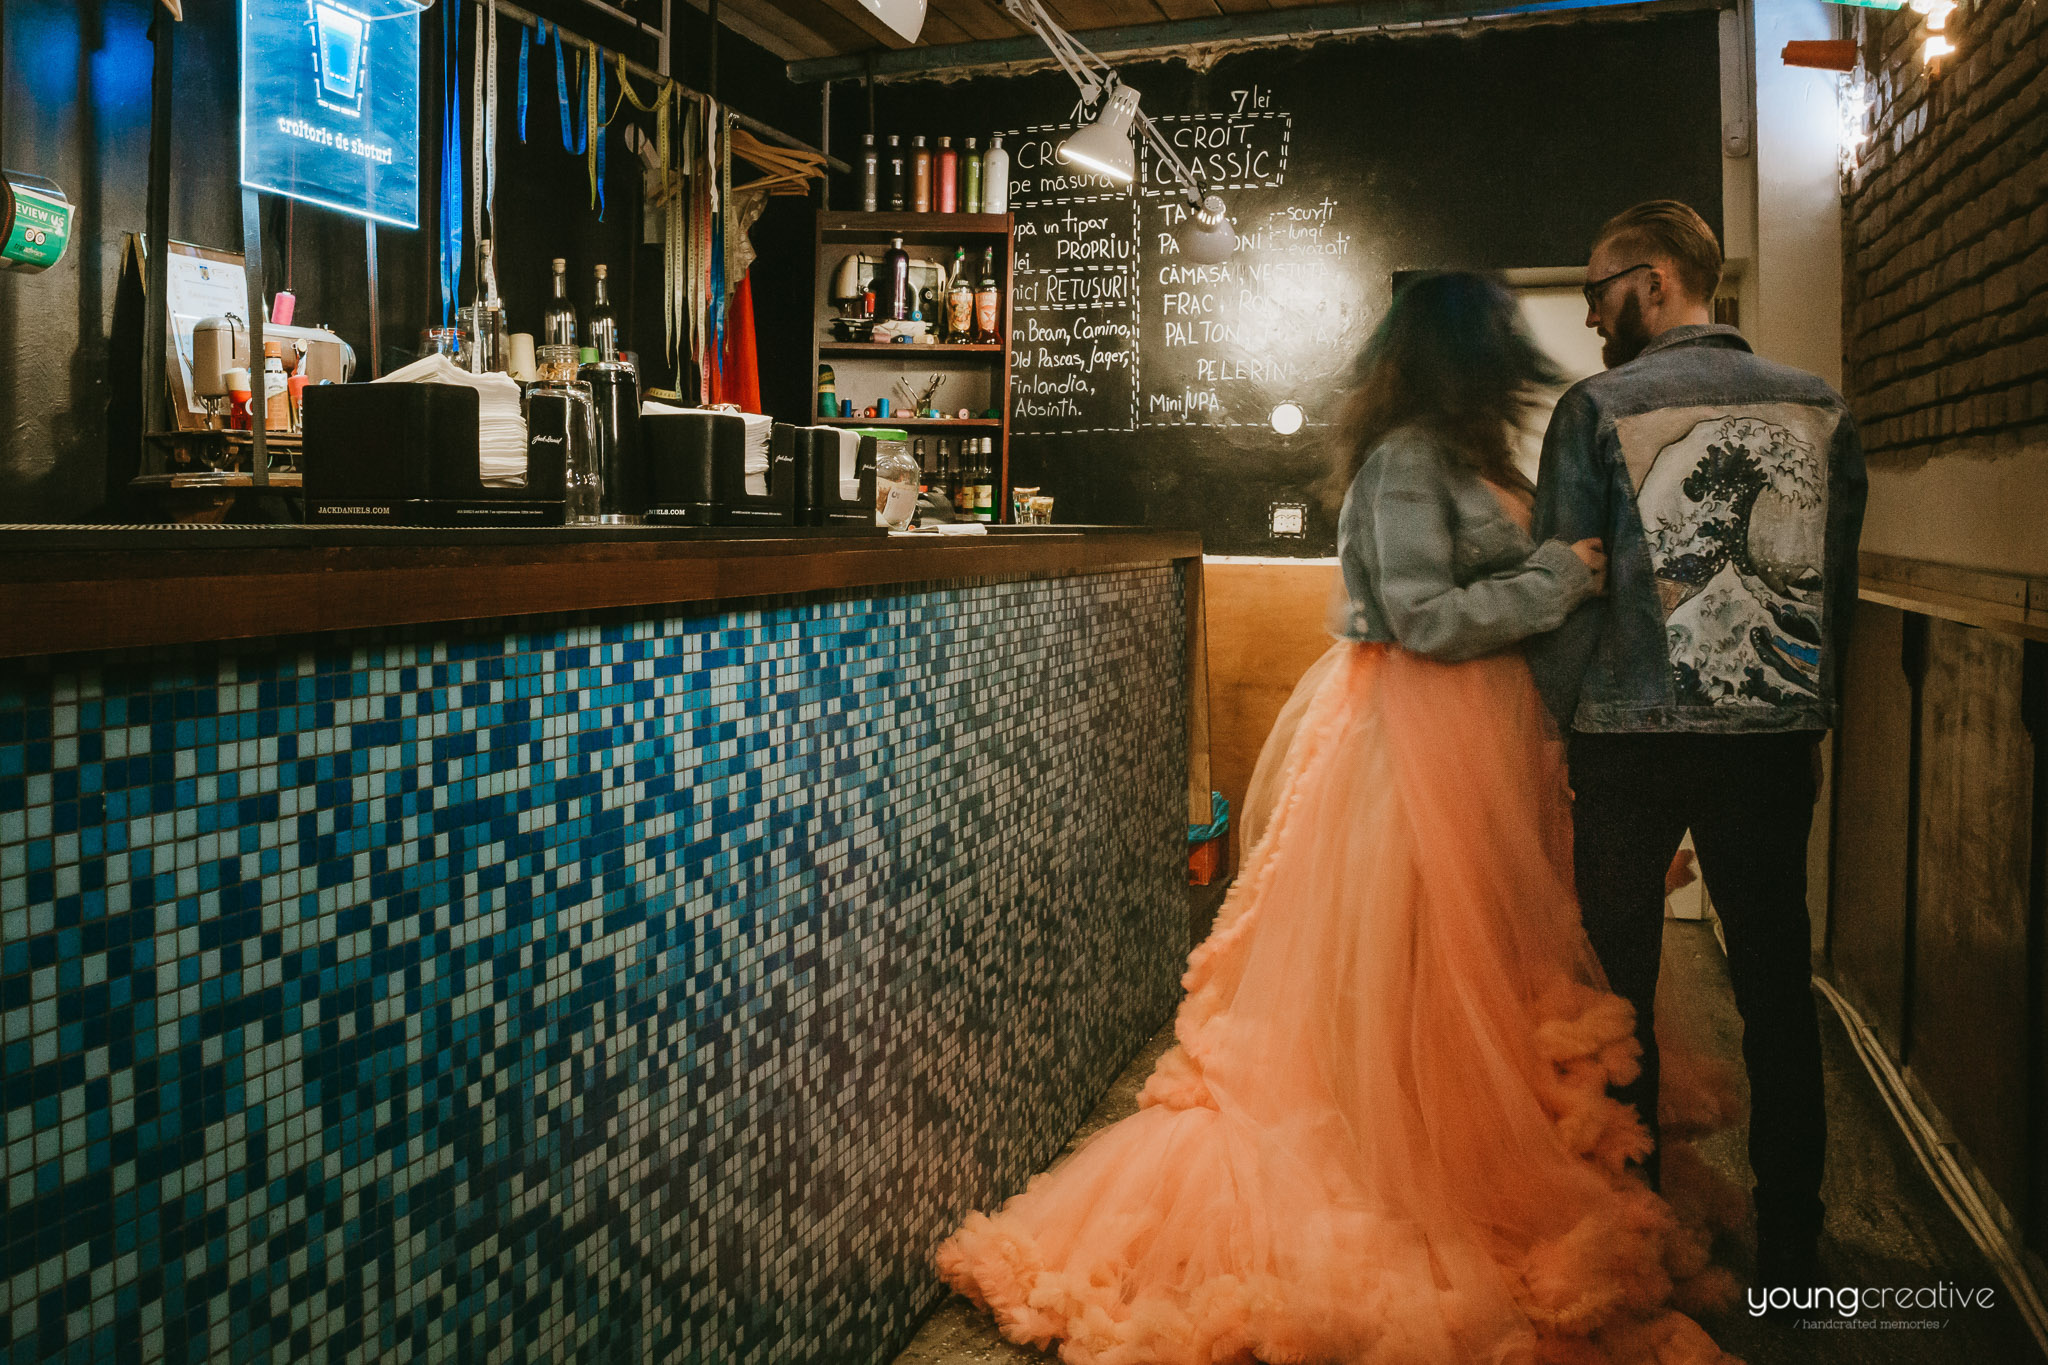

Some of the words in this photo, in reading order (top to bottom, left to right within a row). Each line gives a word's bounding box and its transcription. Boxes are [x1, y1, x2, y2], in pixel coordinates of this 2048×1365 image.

[1231, 90, 1249, 113] 7
[1254, 84, 1272, 109] lei
[278, 117, 333, 146] croitorie
[335, 132, 350, 151] de
[351, 137, 393, 164] shoturi
[1174, 118, 1255, 149] CROIT
[1155, 143, 1270, 185] CLASSIC
[1009, 179, 1031, 200] pe
[50, 214, 65, 228] US
[1043, 223, 1060, 234] un
[1061, 208, 1109, 241] tipar
[1057, 232, 1130, 260] PROPRIU
[1013, 251, 1030, 270] lei
[1028, 317, 1071, 346] Beam,
[1073, 316, 1131, 339] Camino,
[1010, 372, 1096, 396] Finlandia,
[1015, 397, 1083, 418] Absinth.
[317, 506, 390, 515] JACKDANIELS.COM
